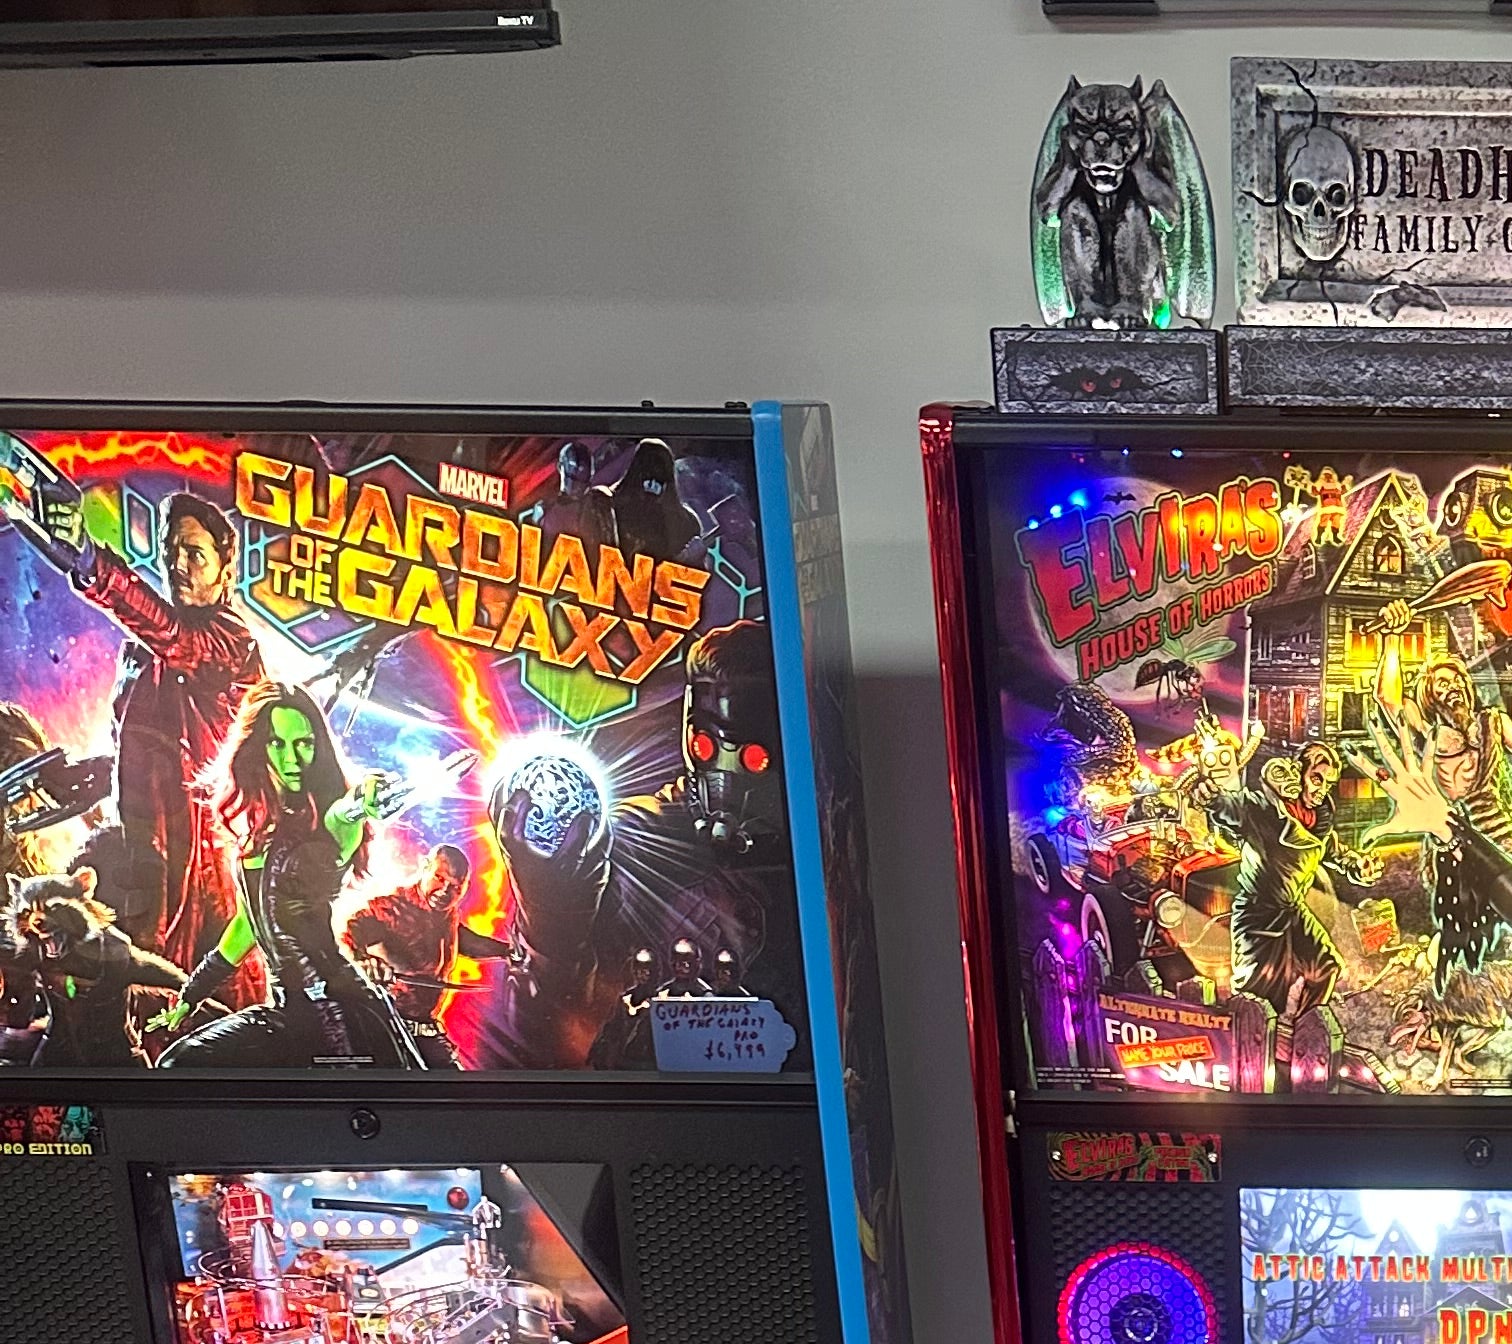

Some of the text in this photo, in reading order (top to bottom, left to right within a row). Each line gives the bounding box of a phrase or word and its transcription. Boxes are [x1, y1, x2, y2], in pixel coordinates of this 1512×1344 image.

[520, 15, 534, 26] TV
[1350, 214, 1482, 254] FAMILY
[439, 462, 508, 509] MARVEL
[235, 451, 711, 631] GUARDIANS
[290, 535, 338, 569] OF
[268, 561, 333, 604] THE
[337, 549, 684, 685] GALAXY
[1078, 565, 1274, 682] HOUSE OF HORRORS
[655, 1003, 751, 1019] GUARDIANS
[1100, 994, 1231, 1030] ALTERNATE REALTY
[1105, 1018, 1158, 1045] FOR
[1121, 1040, 1207, 1062] NAME YOUR PRICE
[1159, 1061, 1230, 1091] SALE
[28, 1143, 93, 1155] EDITION
[1252, 1254, 1324, 1283] ATTIC
[1333, 1254, 1430, 1283] ATTACK
